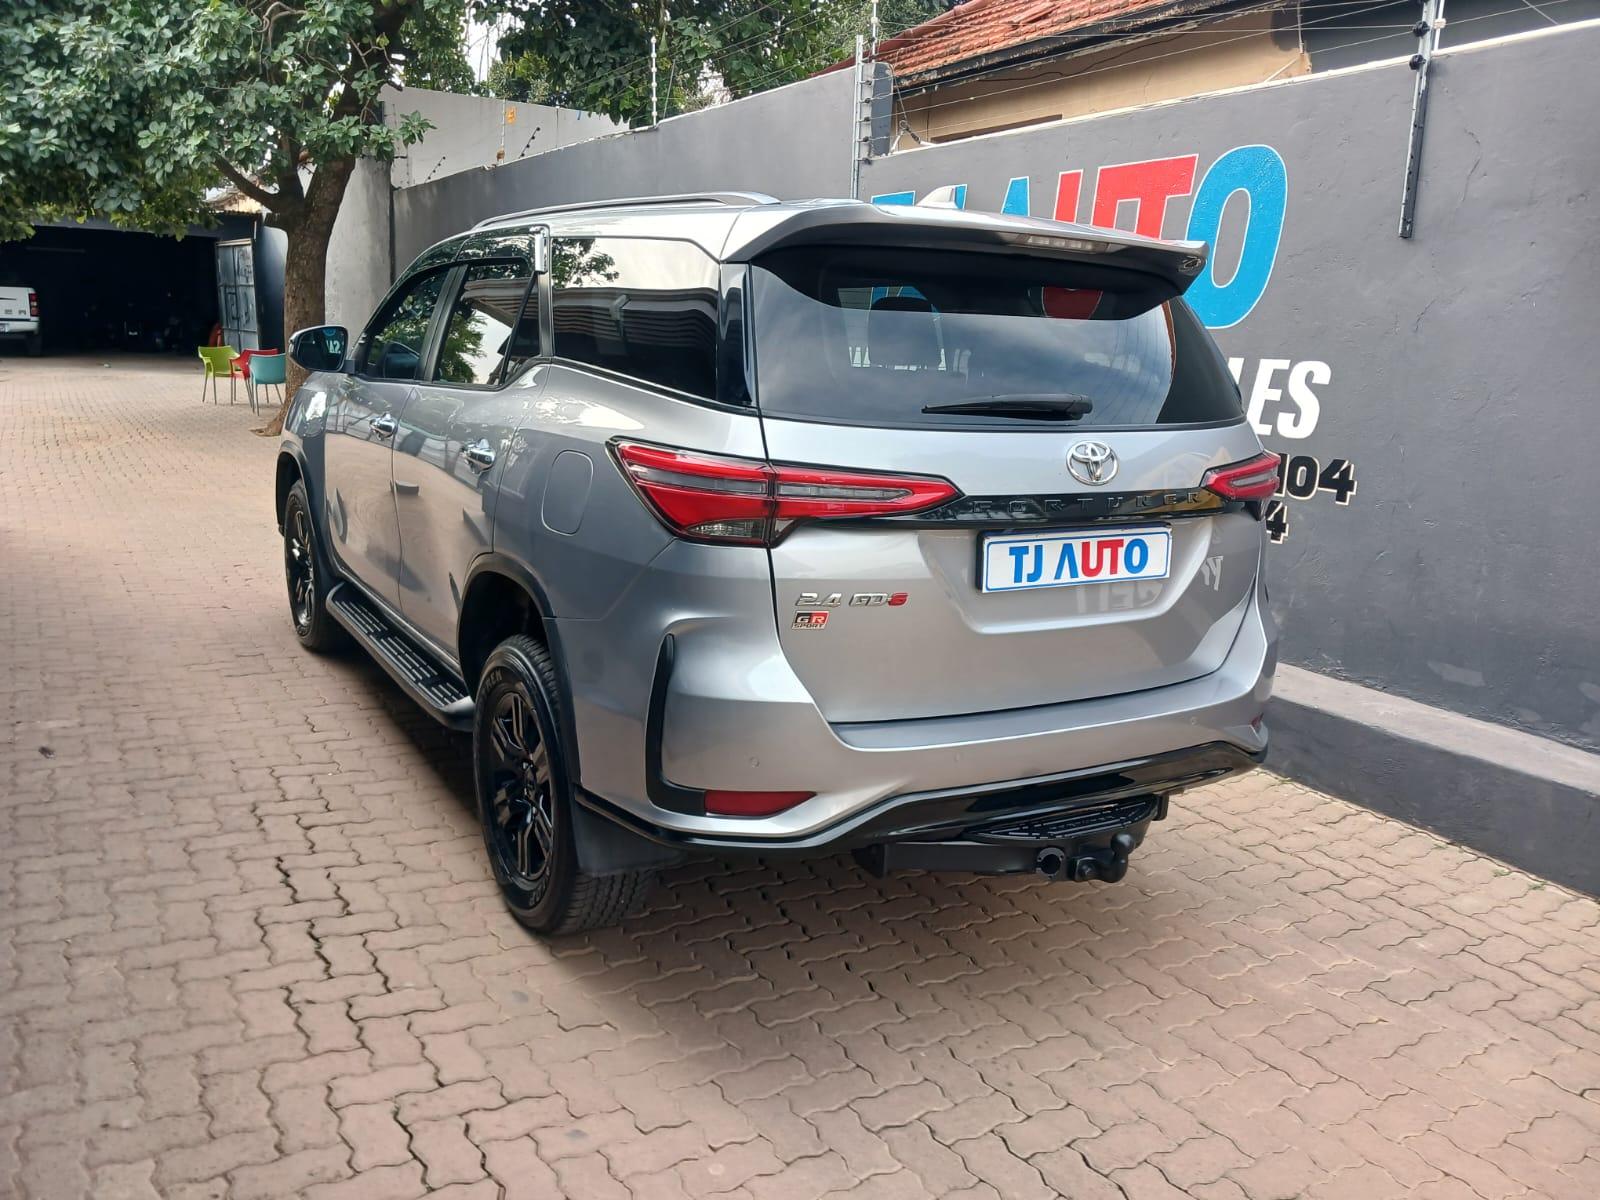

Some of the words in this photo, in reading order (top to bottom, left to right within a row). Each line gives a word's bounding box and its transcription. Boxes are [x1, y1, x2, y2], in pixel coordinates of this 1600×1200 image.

[972, 491, 1201, 514] FORTUNER
[1008, 544, 1043, 584] TJ
[1054, 538, 1149, 580] AUTO
[796, 592, 842, 607] 2.4
